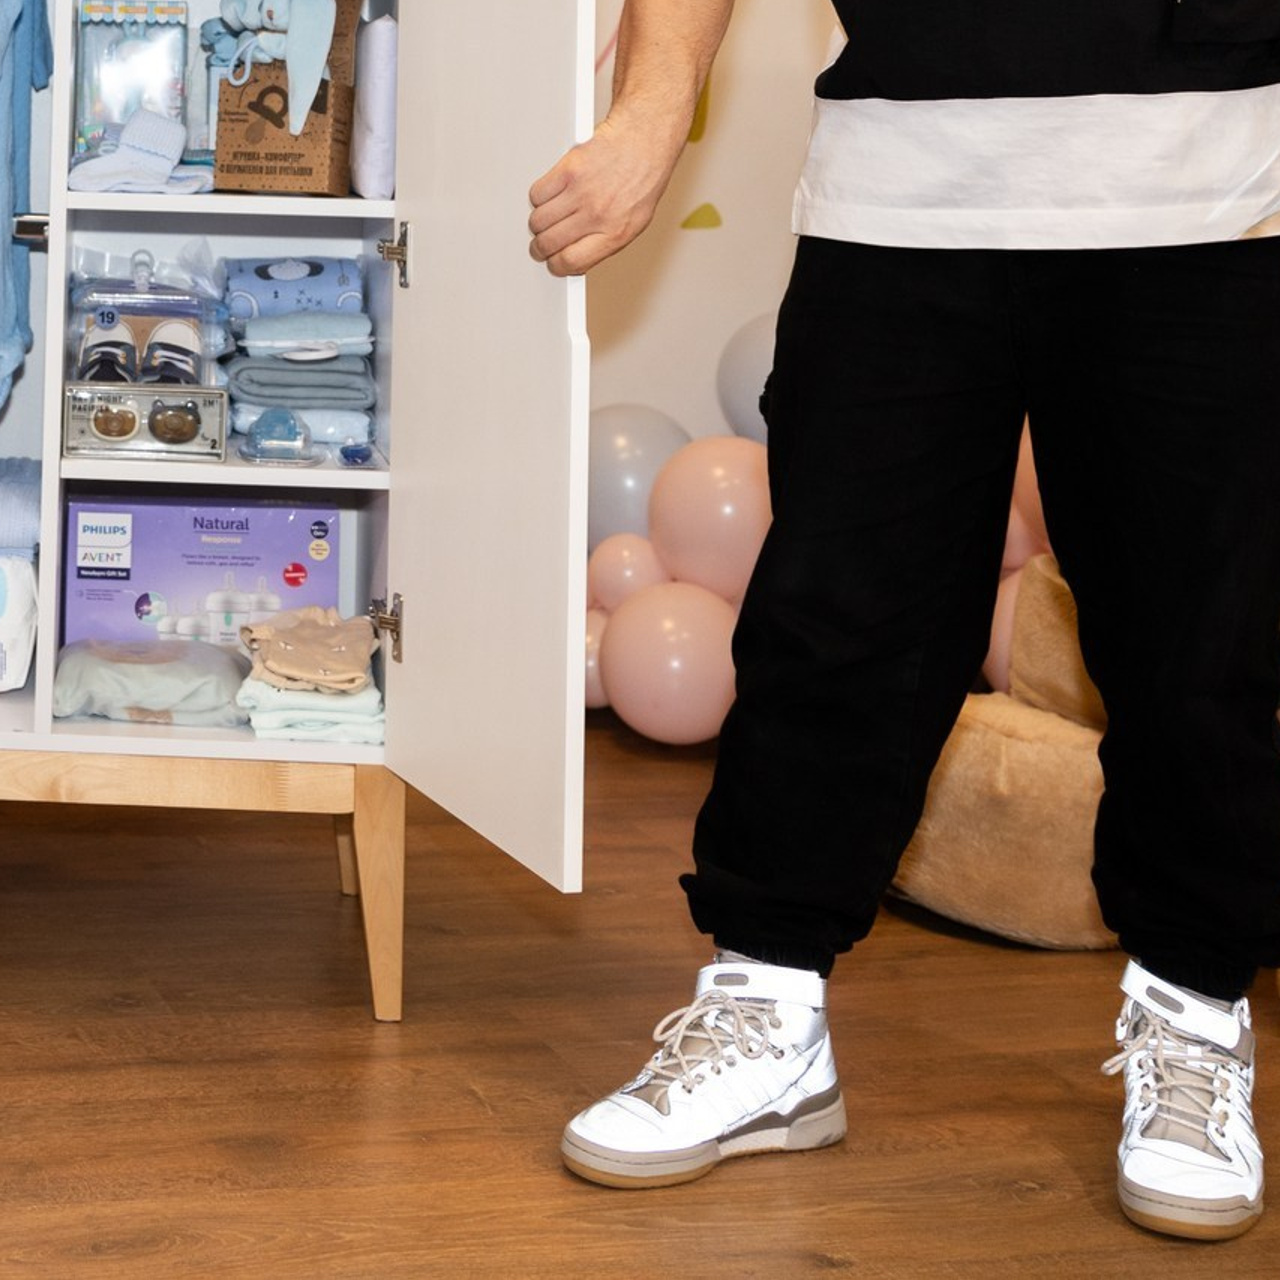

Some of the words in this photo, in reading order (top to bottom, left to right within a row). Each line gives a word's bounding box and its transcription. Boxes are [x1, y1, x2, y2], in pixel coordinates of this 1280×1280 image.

[98, 311, 115, 325] 19
[210, 439, 218, 450] 2
[193, 516, 250, 531] Natural
[82, 524, 127, 536] PHILIPS
[82, 552, 123, 563] AVENT
